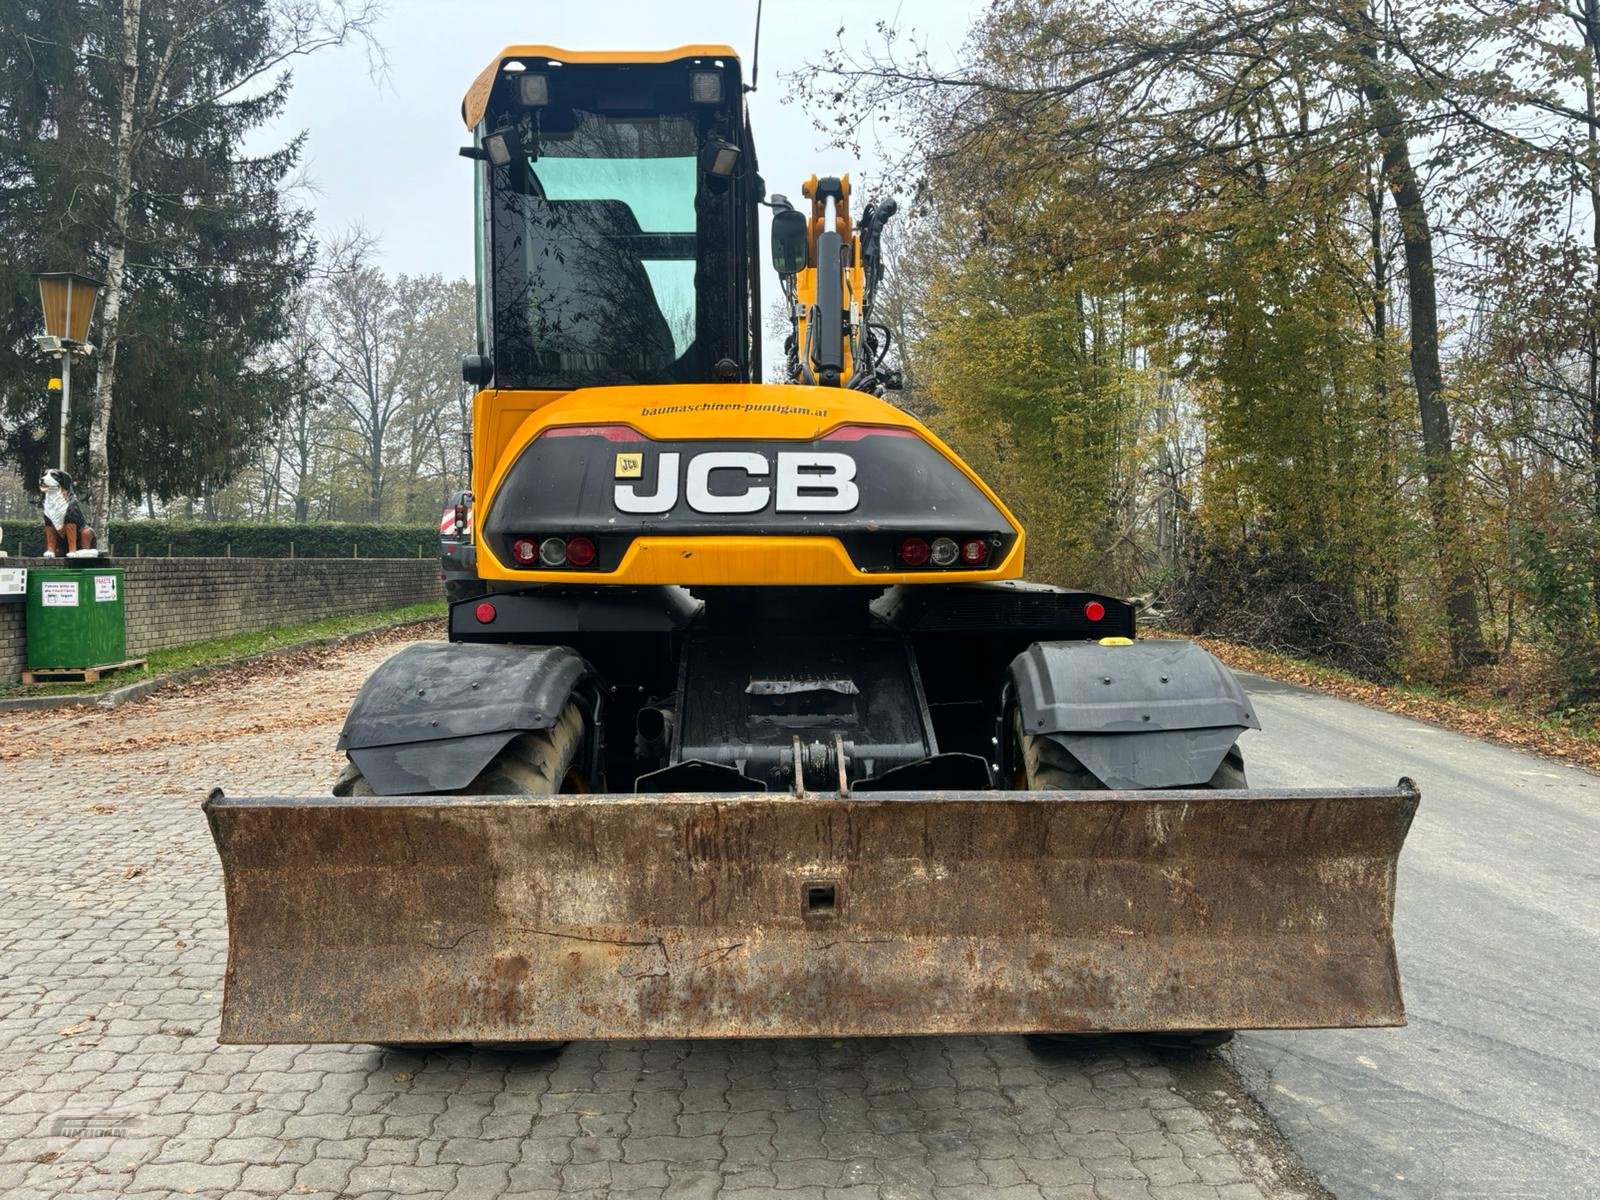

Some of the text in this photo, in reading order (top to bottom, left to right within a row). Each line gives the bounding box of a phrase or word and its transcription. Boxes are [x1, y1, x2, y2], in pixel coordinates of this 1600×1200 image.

[641, 402, 828, 417] baumaschinen-puntigam.at
[622, 458, 638, 471] JCB
[614, 452, 860, 513] JCB
